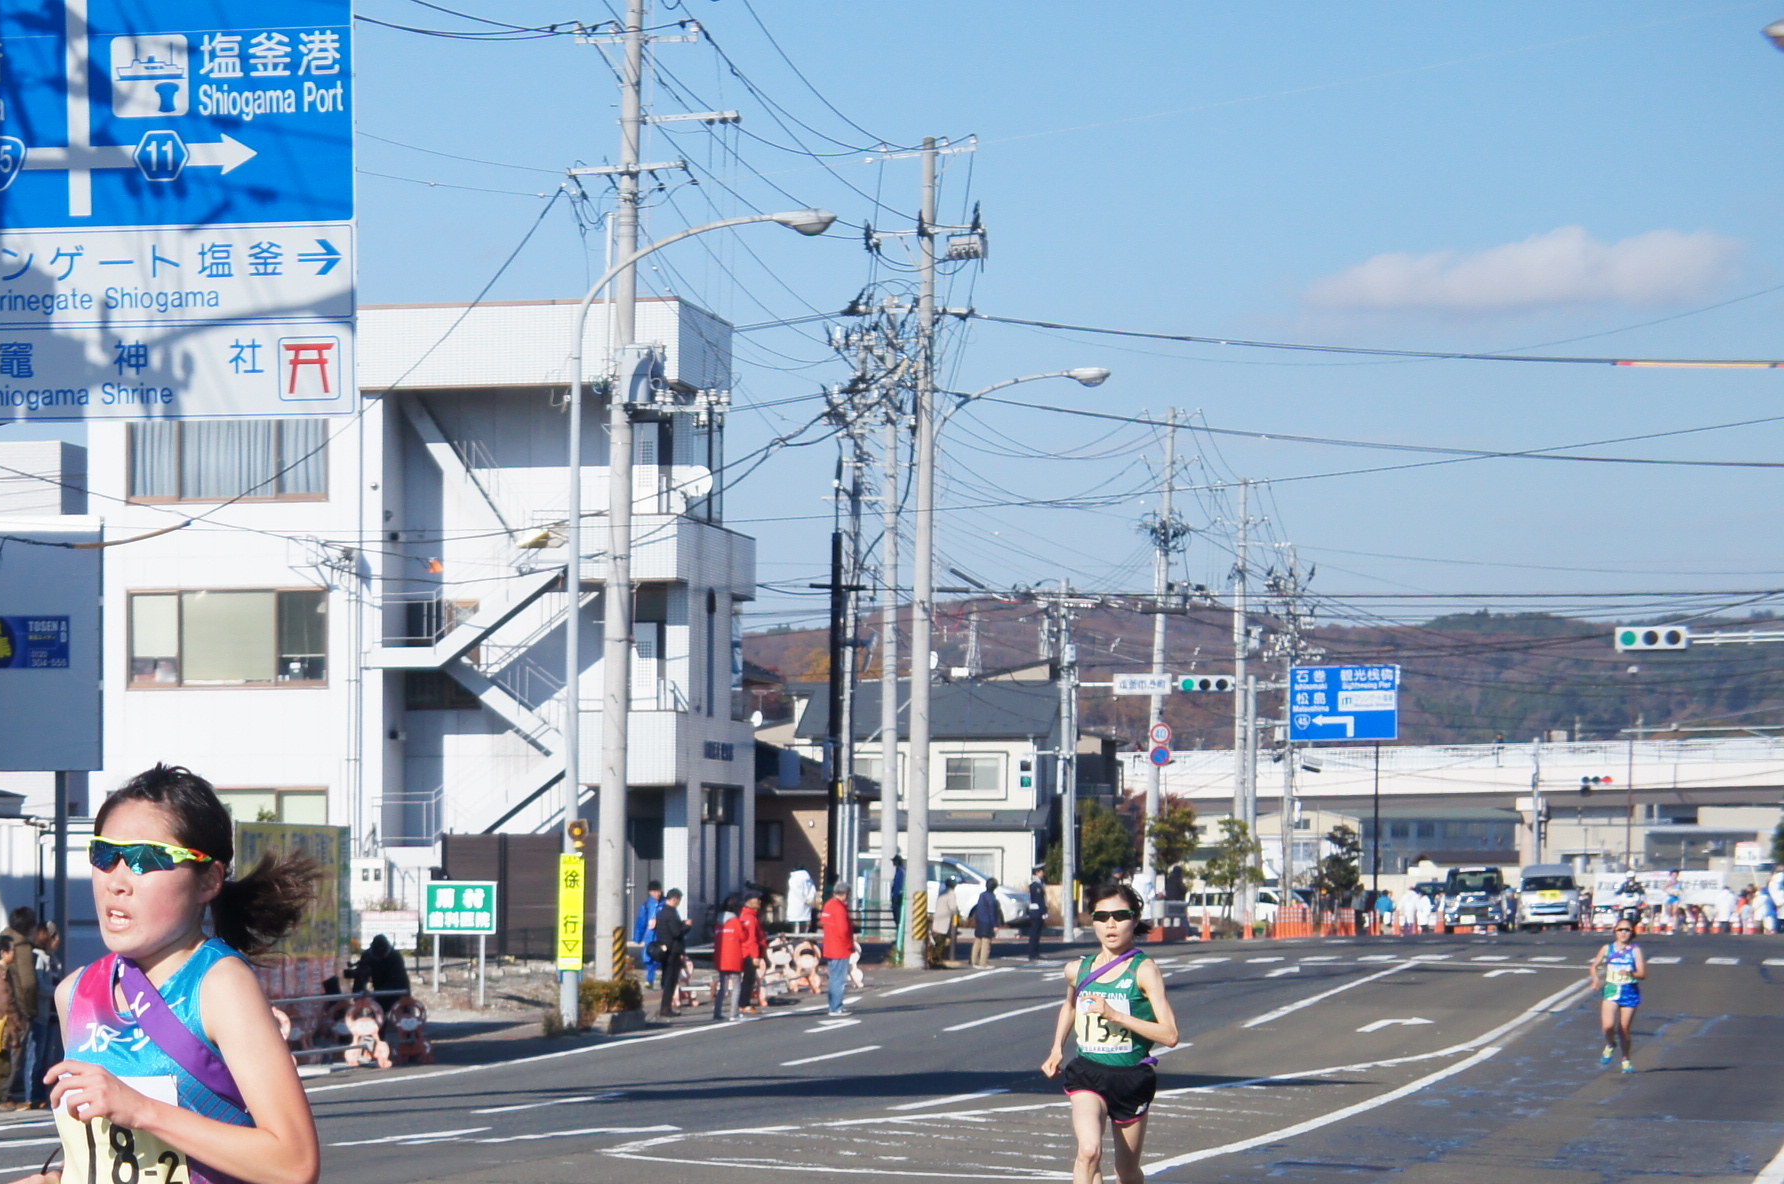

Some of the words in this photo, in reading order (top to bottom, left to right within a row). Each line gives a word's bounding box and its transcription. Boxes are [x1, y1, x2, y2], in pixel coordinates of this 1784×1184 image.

[199, 30, 341, 78] 塩釜港
[199, 83, 296, 121] Shiogama
[303, 80, 344, 113] Port
[145, 140, 174, 171] 11
[104, 286, 220, 314] Shiogama
[100, 382, 174, 406] Shrine
[28, 620, 58, 632] TOSEN
[1155, 729, 1167, 740] 40
[563, 869, 580, 935] 徐行
[1084, 1015, 1130, 1043] 15-2
